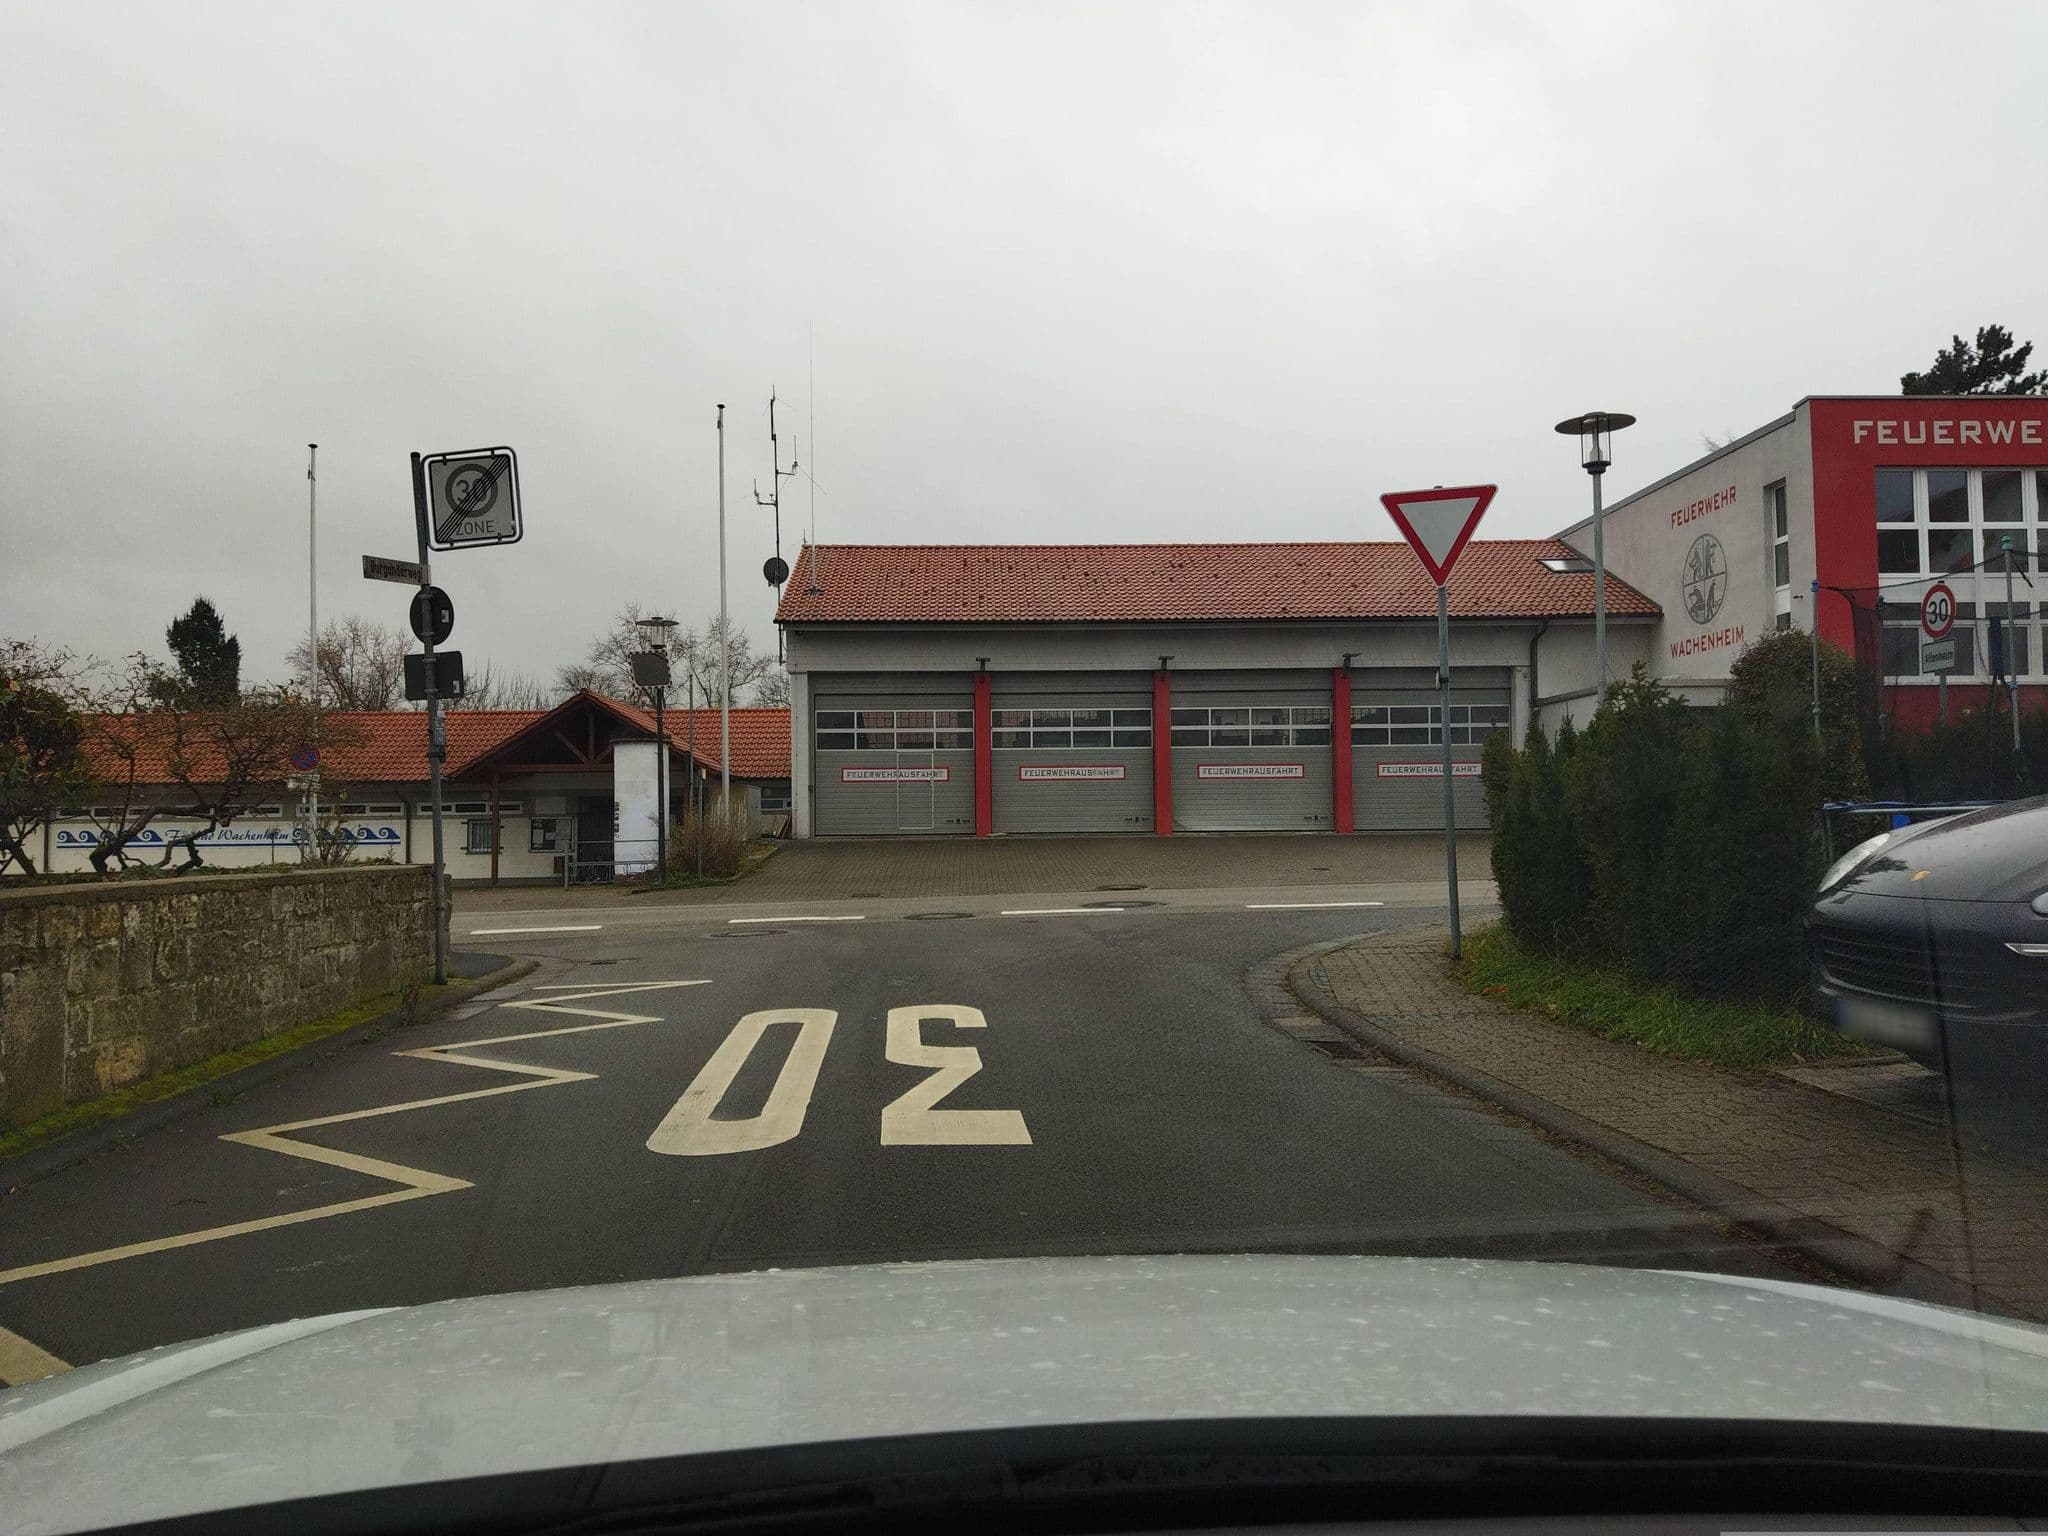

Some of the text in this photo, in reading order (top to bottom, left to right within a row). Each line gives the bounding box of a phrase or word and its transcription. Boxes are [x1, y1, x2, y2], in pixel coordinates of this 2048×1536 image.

[1853, 420, 2044, 445] FEUERWE
[1671, 485, 1737, 529] FEUERWEHR
[455, 520, 495, 536] ZONE
[1928, 598, 1949, 625] 30
[1670, 624, 1745, 659] WACHENHEIM
[1202, 767, 1299, 776] FEUERWEHRAUSFAHRT
[1382, 765, 1478, 774] FEUERWEHRAUFAHRT
